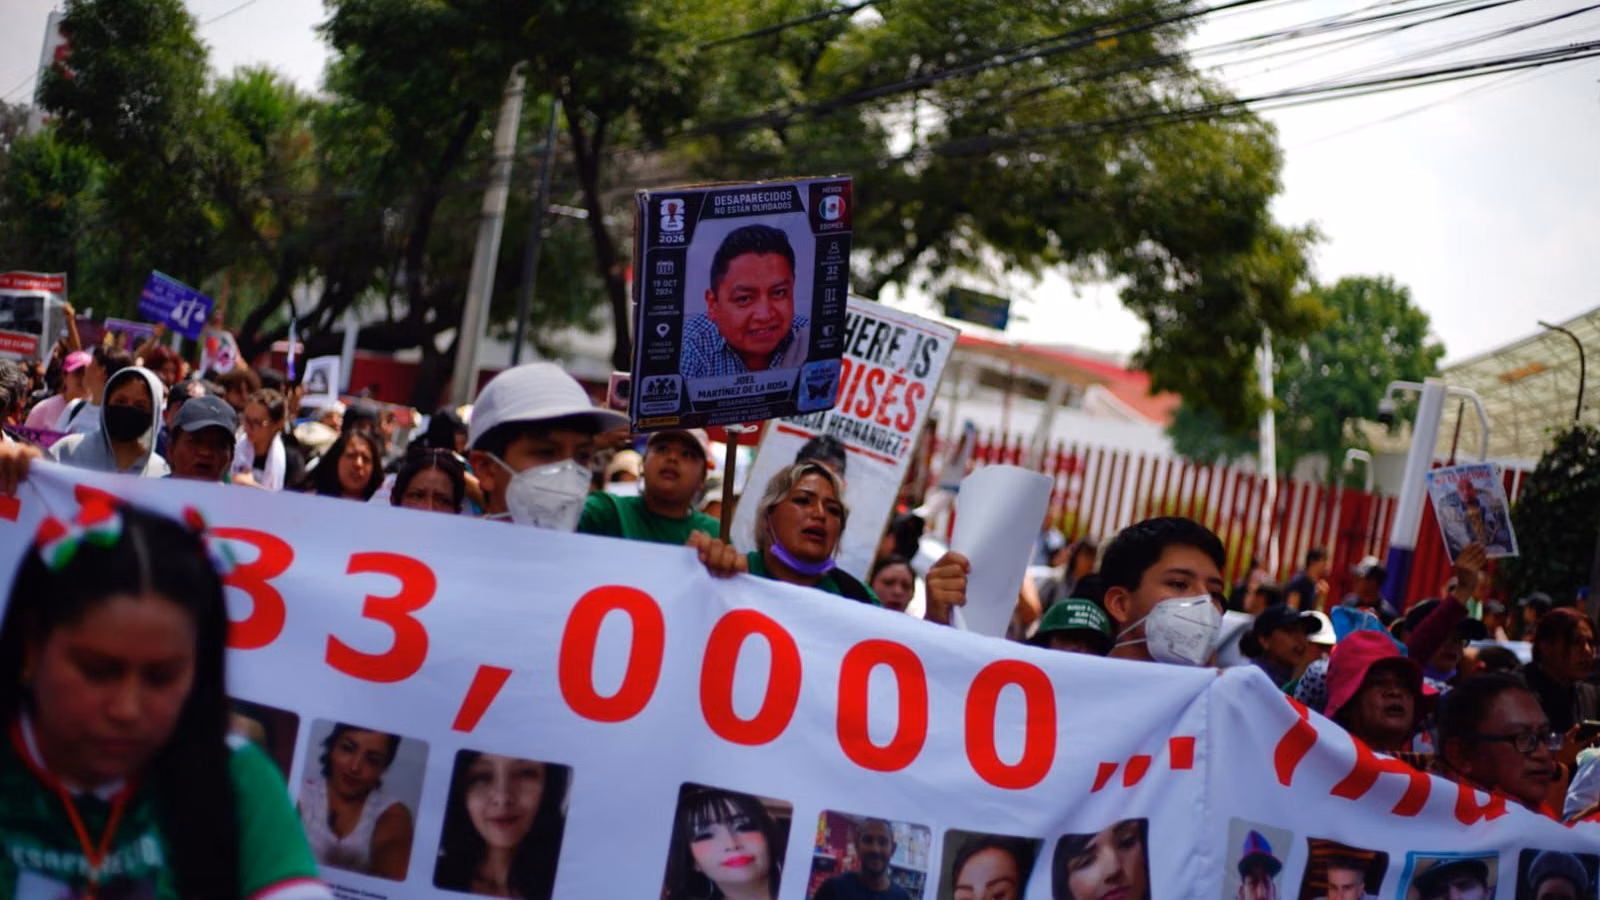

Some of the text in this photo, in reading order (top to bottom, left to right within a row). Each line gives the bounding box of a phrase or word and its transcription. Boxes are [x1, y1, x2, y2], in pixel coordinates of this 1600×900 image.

[714, 190, 792, 206] DESAPARECIDOS
[714, 207, 726, 215] NO
[752, 201, 792, 212] OLVIDADOS
[659, 235, 685, 243] 2026
[663, 279, 677, 287] OCT
[844, 312, 938, 378] HERE IS
[734, 375, 756, 385] JOEL
[742, 385, 754, 394] DE
[755, 384, 765, 392] LA
